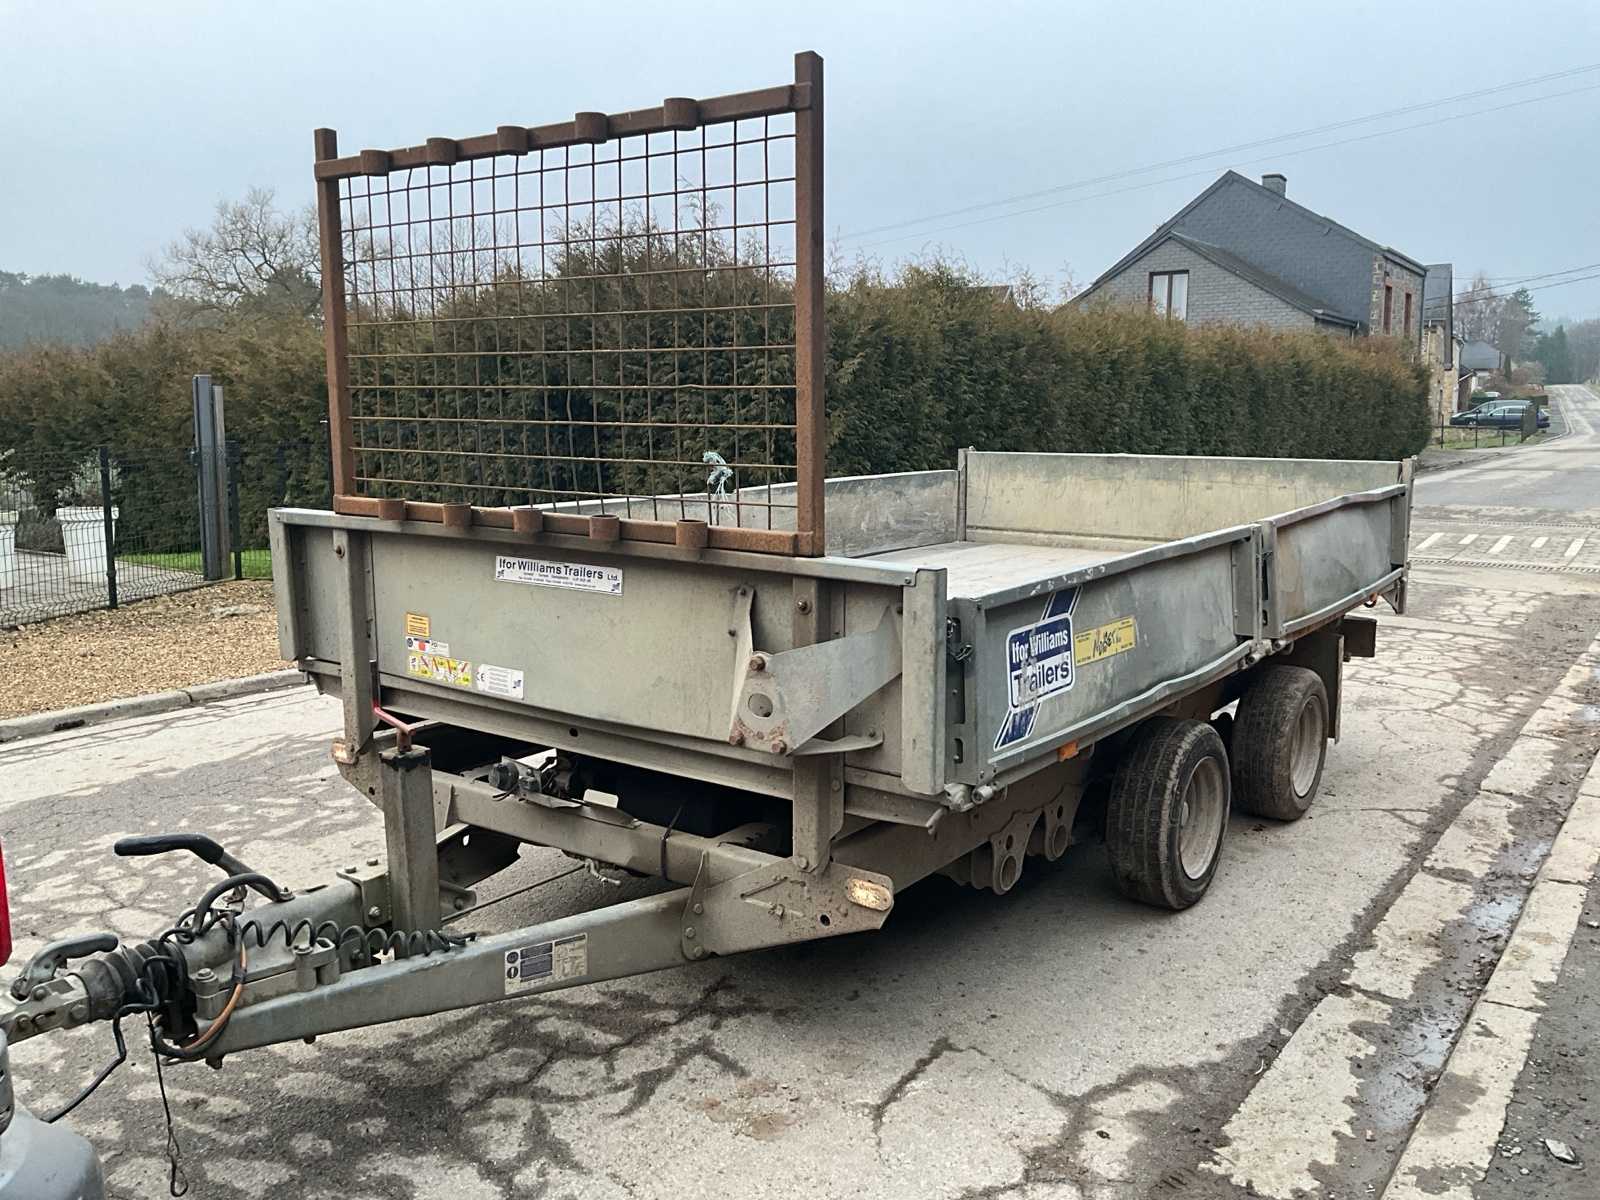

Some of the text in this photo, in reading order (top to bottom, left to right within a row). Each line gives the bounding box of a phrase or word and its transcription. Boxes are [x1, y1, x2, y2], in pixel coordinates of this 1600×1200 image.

[499, 558, 516, 570] Ifor
[517, 560, 562, 575] Williams
[563, 565, 604, 580] Trailers
[1012, 629, 1068, 664] Ifor Williams
[1013, 660, 1069, 699] Trailers
